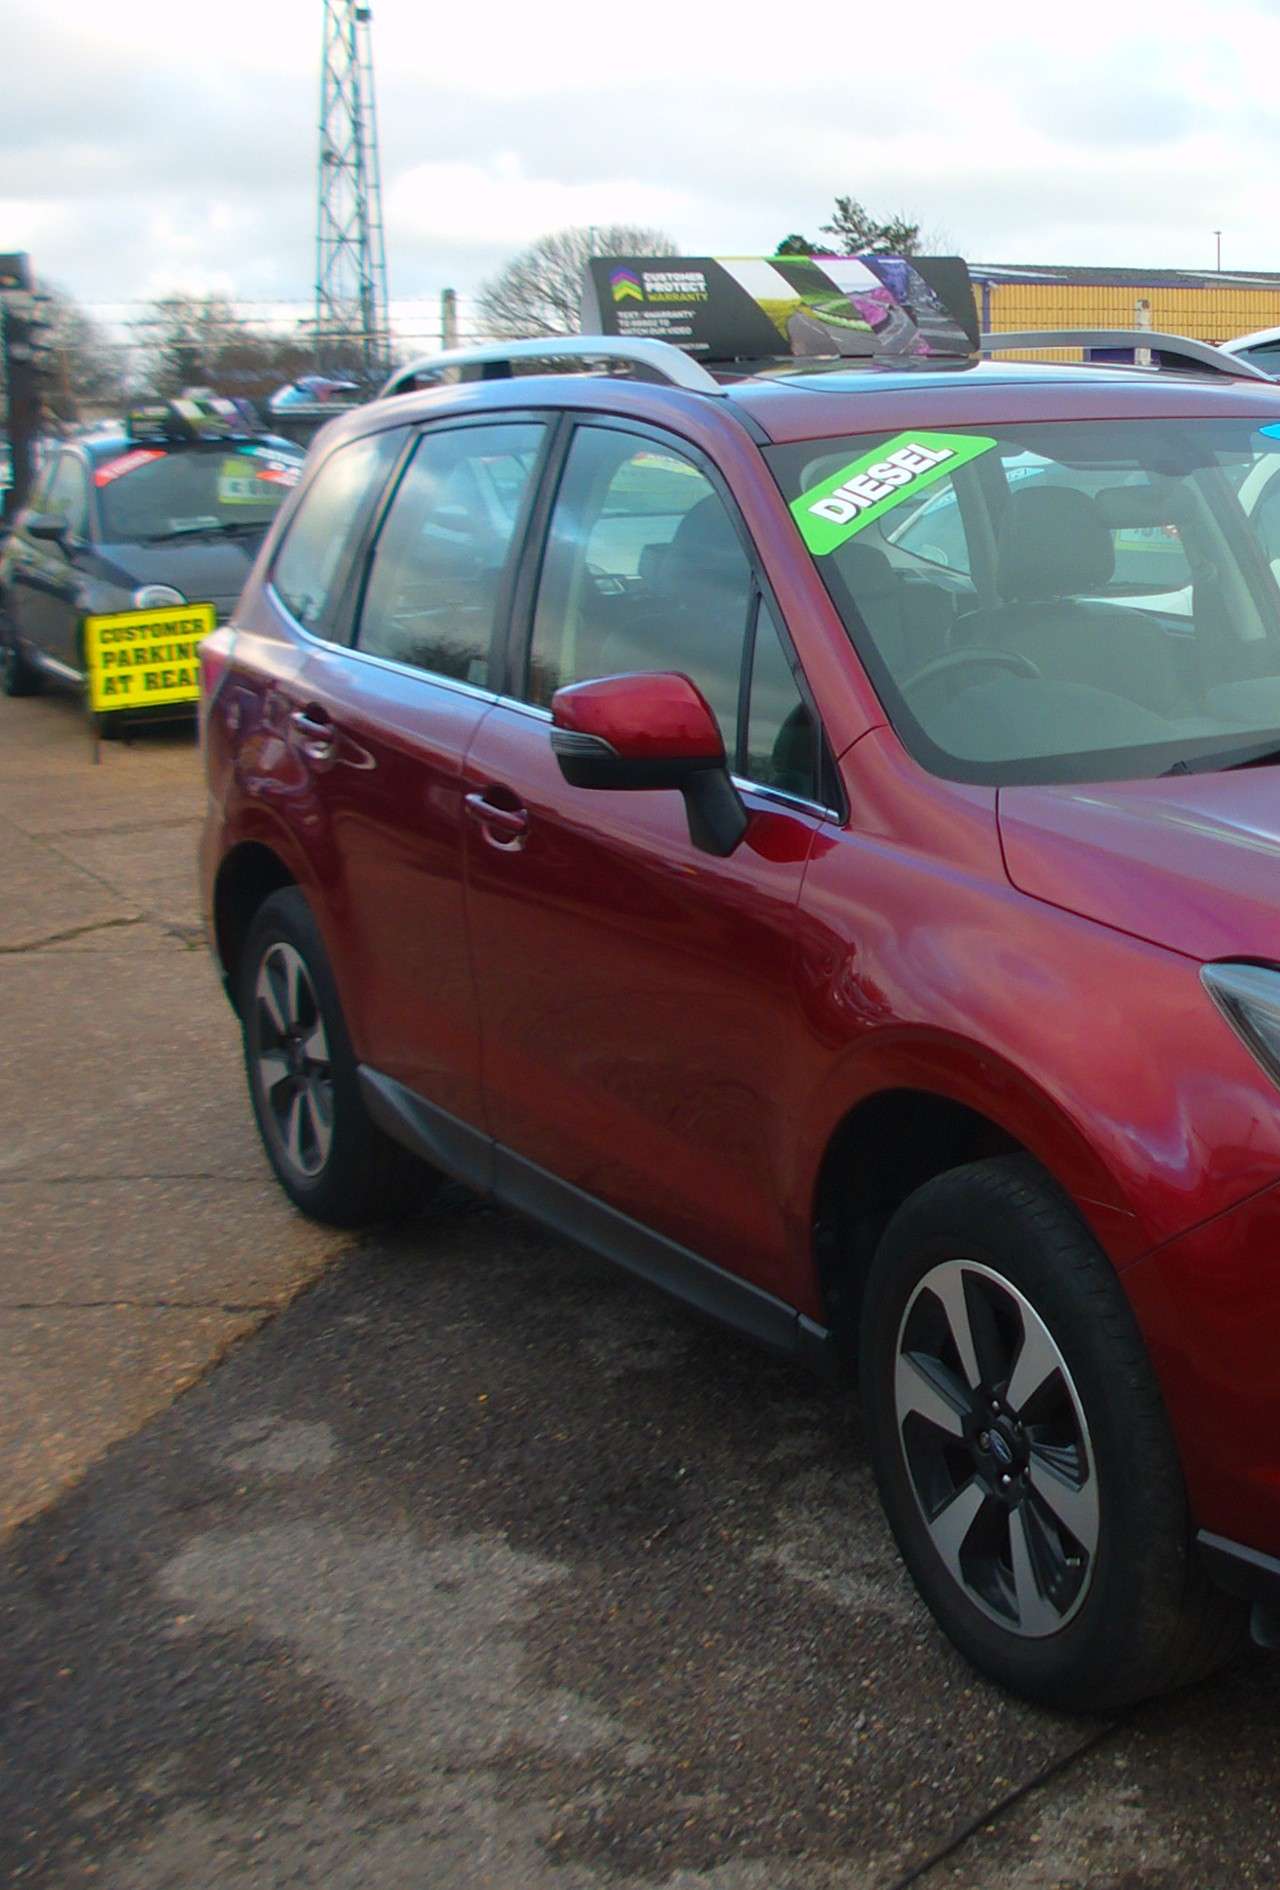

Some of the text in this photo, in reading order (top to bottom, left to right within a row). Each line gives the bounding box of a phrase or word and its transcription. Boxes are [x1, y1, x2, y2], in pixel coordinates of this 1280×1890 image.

[643, 282, 707, 292] PROTECT
[807, 443, 955, 525] DIESEL
[100, 619, 204, 644] CUSTOMER
[103, 675, 131, 695] AT
